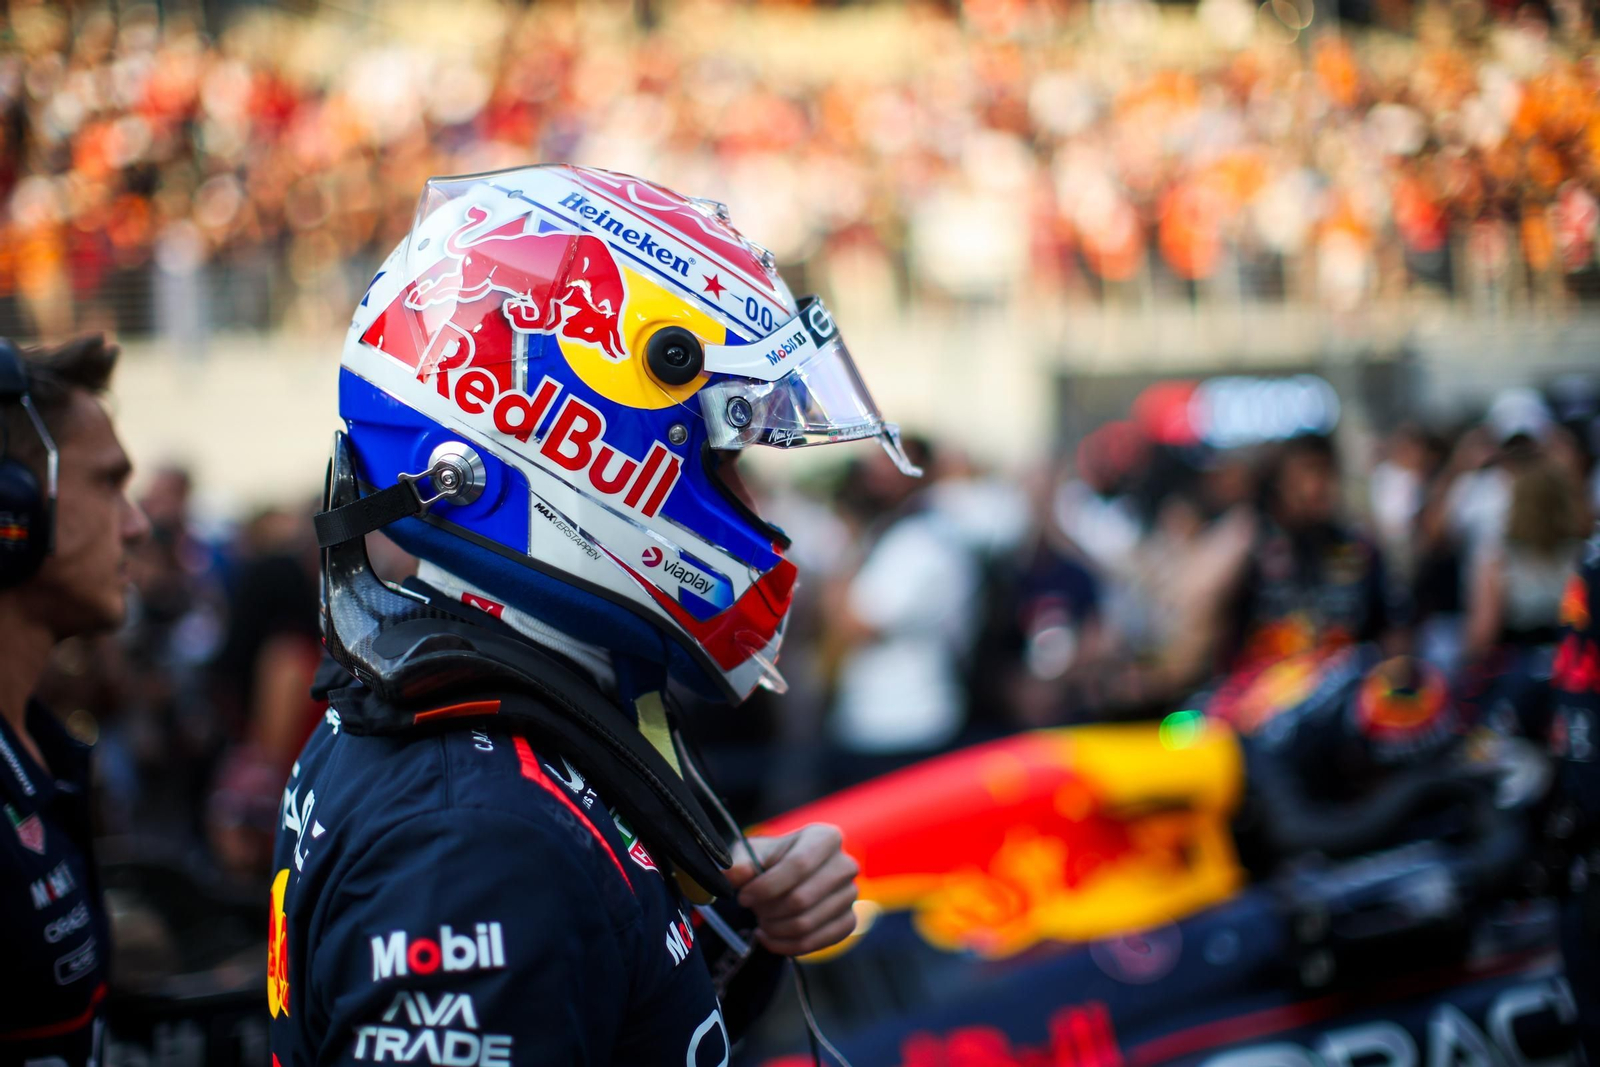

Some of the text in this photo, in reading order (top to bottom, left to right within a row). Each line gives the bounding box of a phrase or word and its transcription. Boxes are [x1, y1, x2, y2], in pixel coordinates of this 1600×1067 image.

[766, 338, 798, 366] Mobil
[416, 322, 681, 518] Red Bull
[663, 559, 715, 594] viaplay
[371, 922, 505, 982] Mobil
[382, 991, 479, 1029] AVA
[353, 1025, 513, 1067] TRADE
